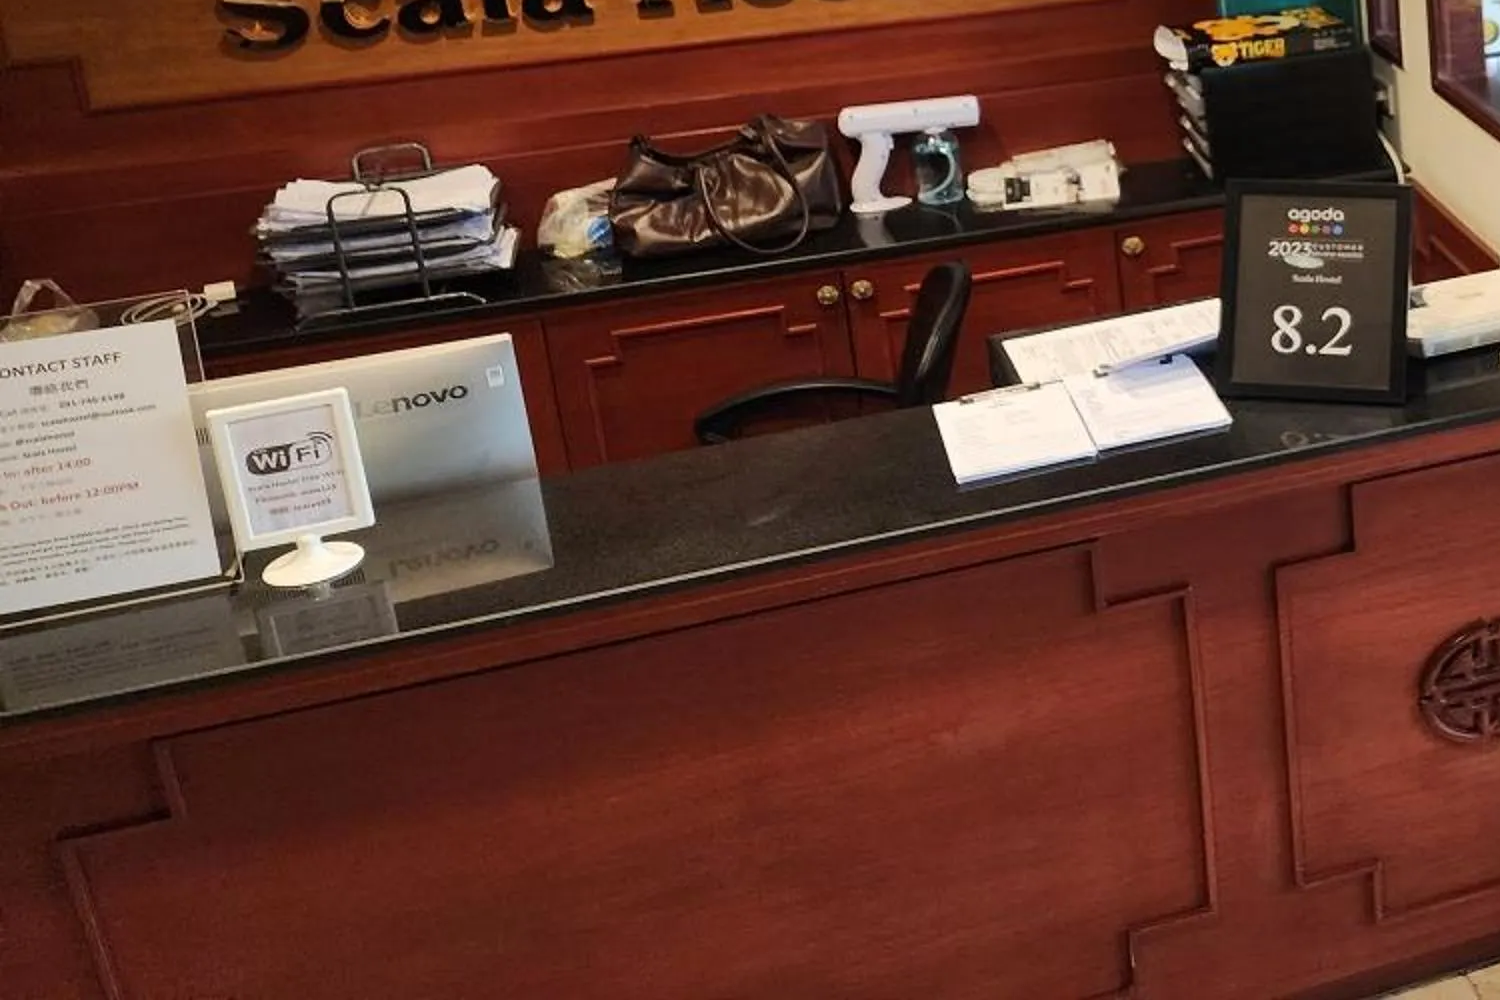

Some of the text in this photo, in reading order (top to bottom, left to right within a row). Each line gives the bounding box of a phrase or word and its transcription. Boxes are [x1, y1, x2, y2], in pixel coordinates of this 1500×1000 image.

[1238, 37, 1285, 58] TIGER
[1287, 207, 1345, 223] agoda
[1268, 240, 1313, 257] 2023
[1271, 304, 1353, 356] 8.2
[0, 351, 122, 380] ONTACT STAFF
